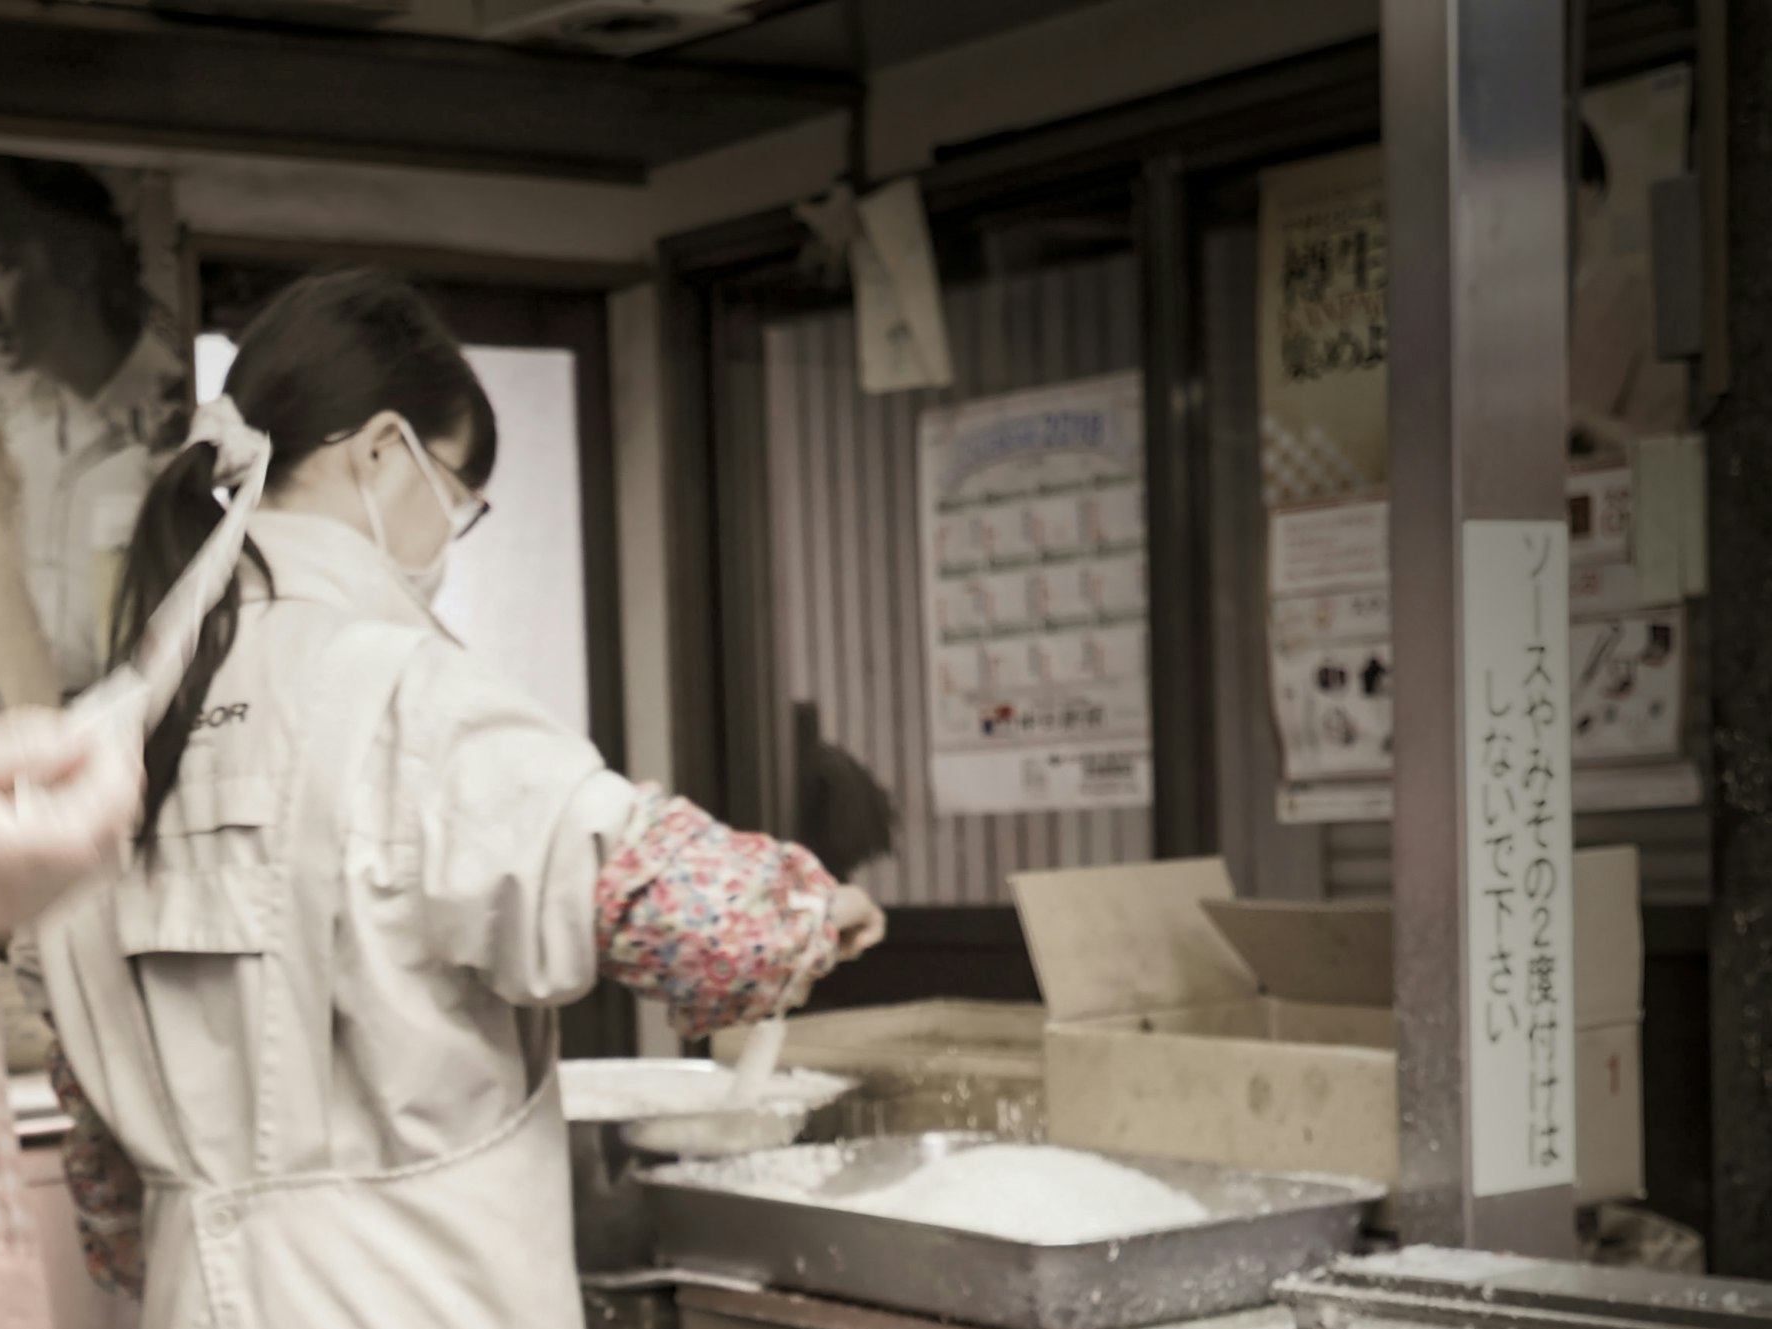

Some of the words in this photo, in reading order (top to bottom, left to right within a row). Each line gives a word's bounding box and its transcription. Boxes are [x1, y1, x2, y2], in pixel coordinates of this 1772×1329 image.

[1481, 669, 1521, 1047] しないで下さい
[1522, 533, 1565, 1170] ソースやみその2度付けは
